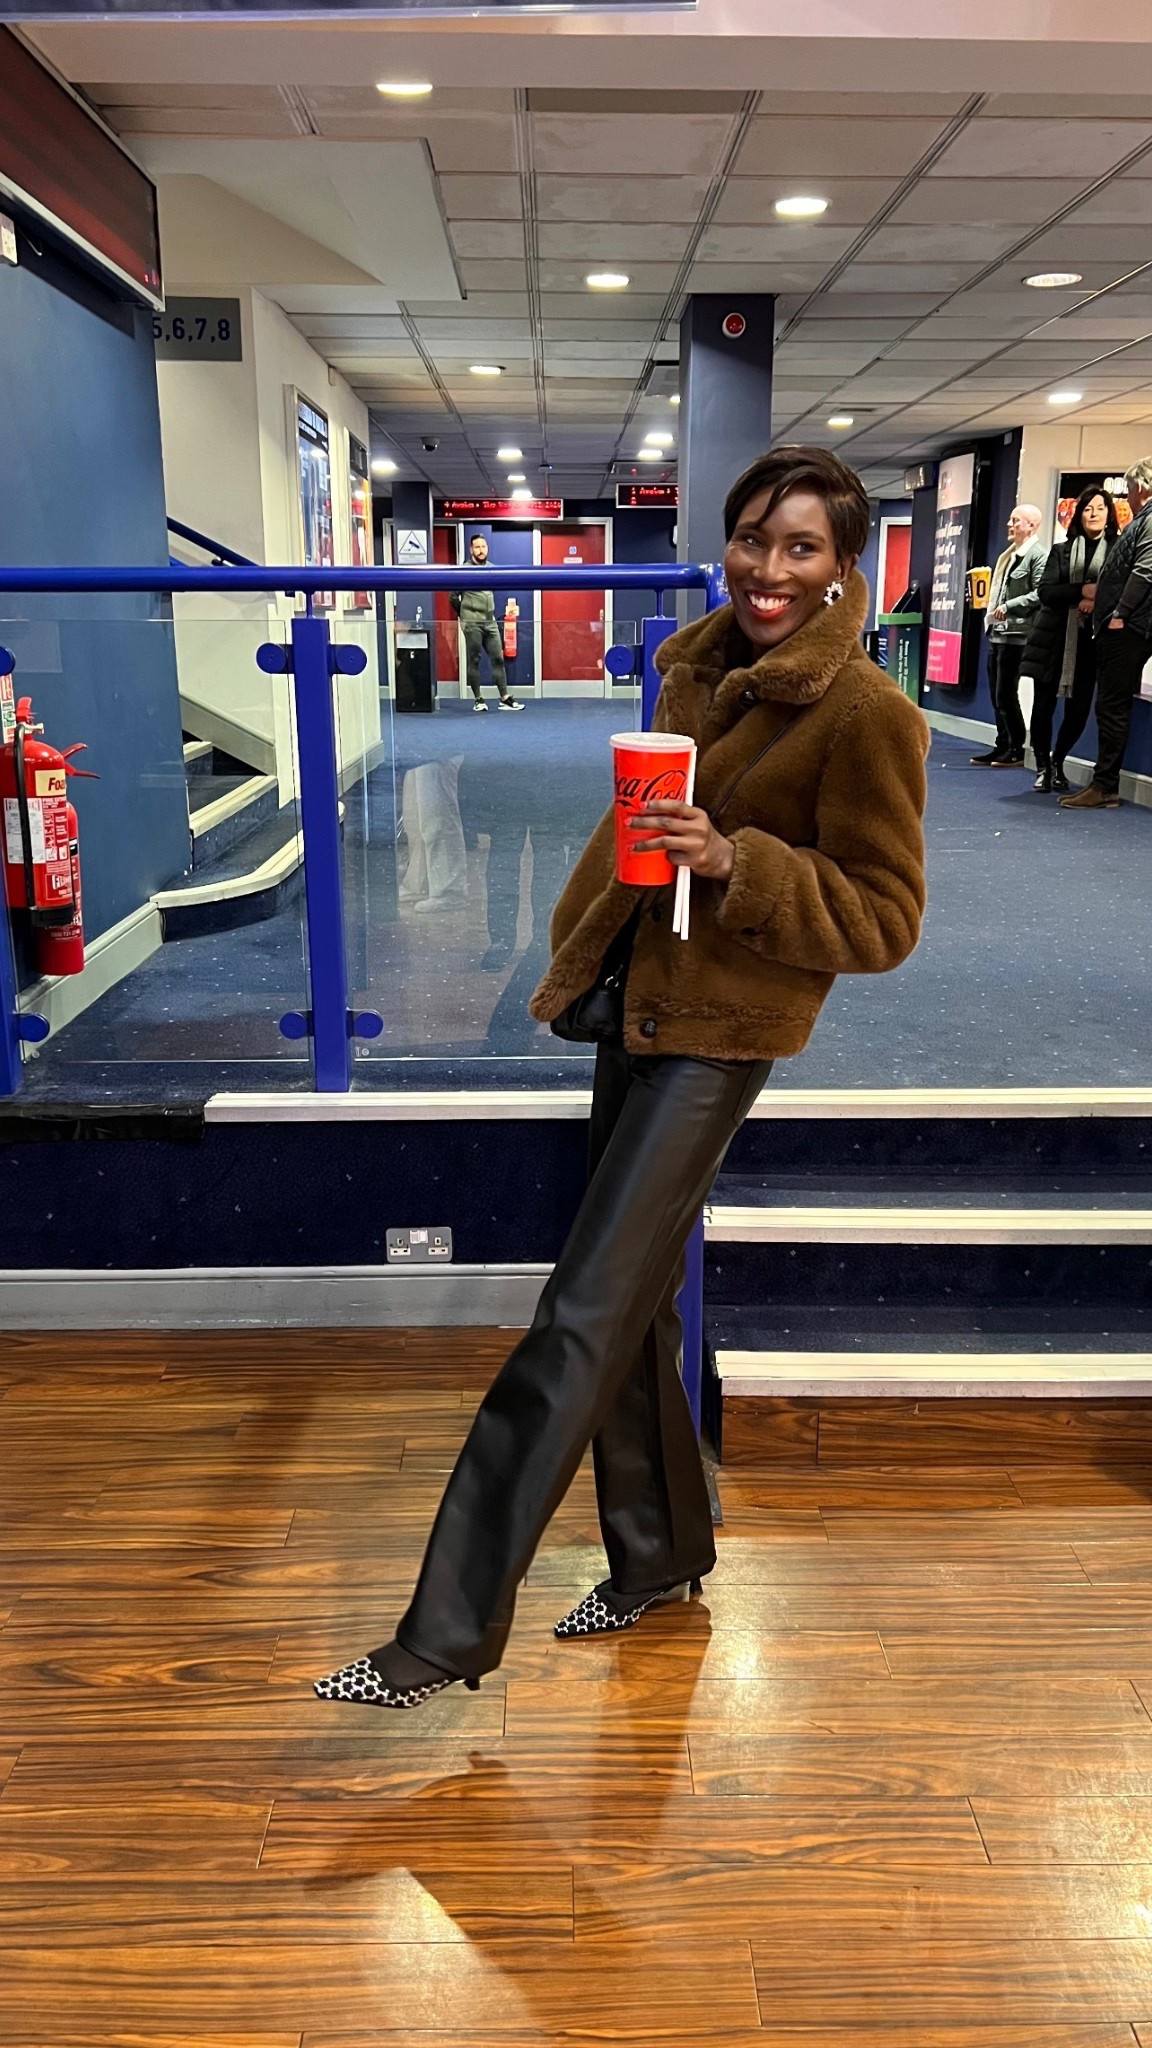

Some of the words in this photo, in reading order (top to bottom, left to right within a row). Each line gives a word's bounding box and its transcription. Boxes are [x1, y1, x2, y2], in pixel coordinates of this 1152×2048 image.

[152, 316, 231, 343] 5,6,7,8
[48, 777, 67, 791] Foa
[614, 770, 688, 802] ca-Col
